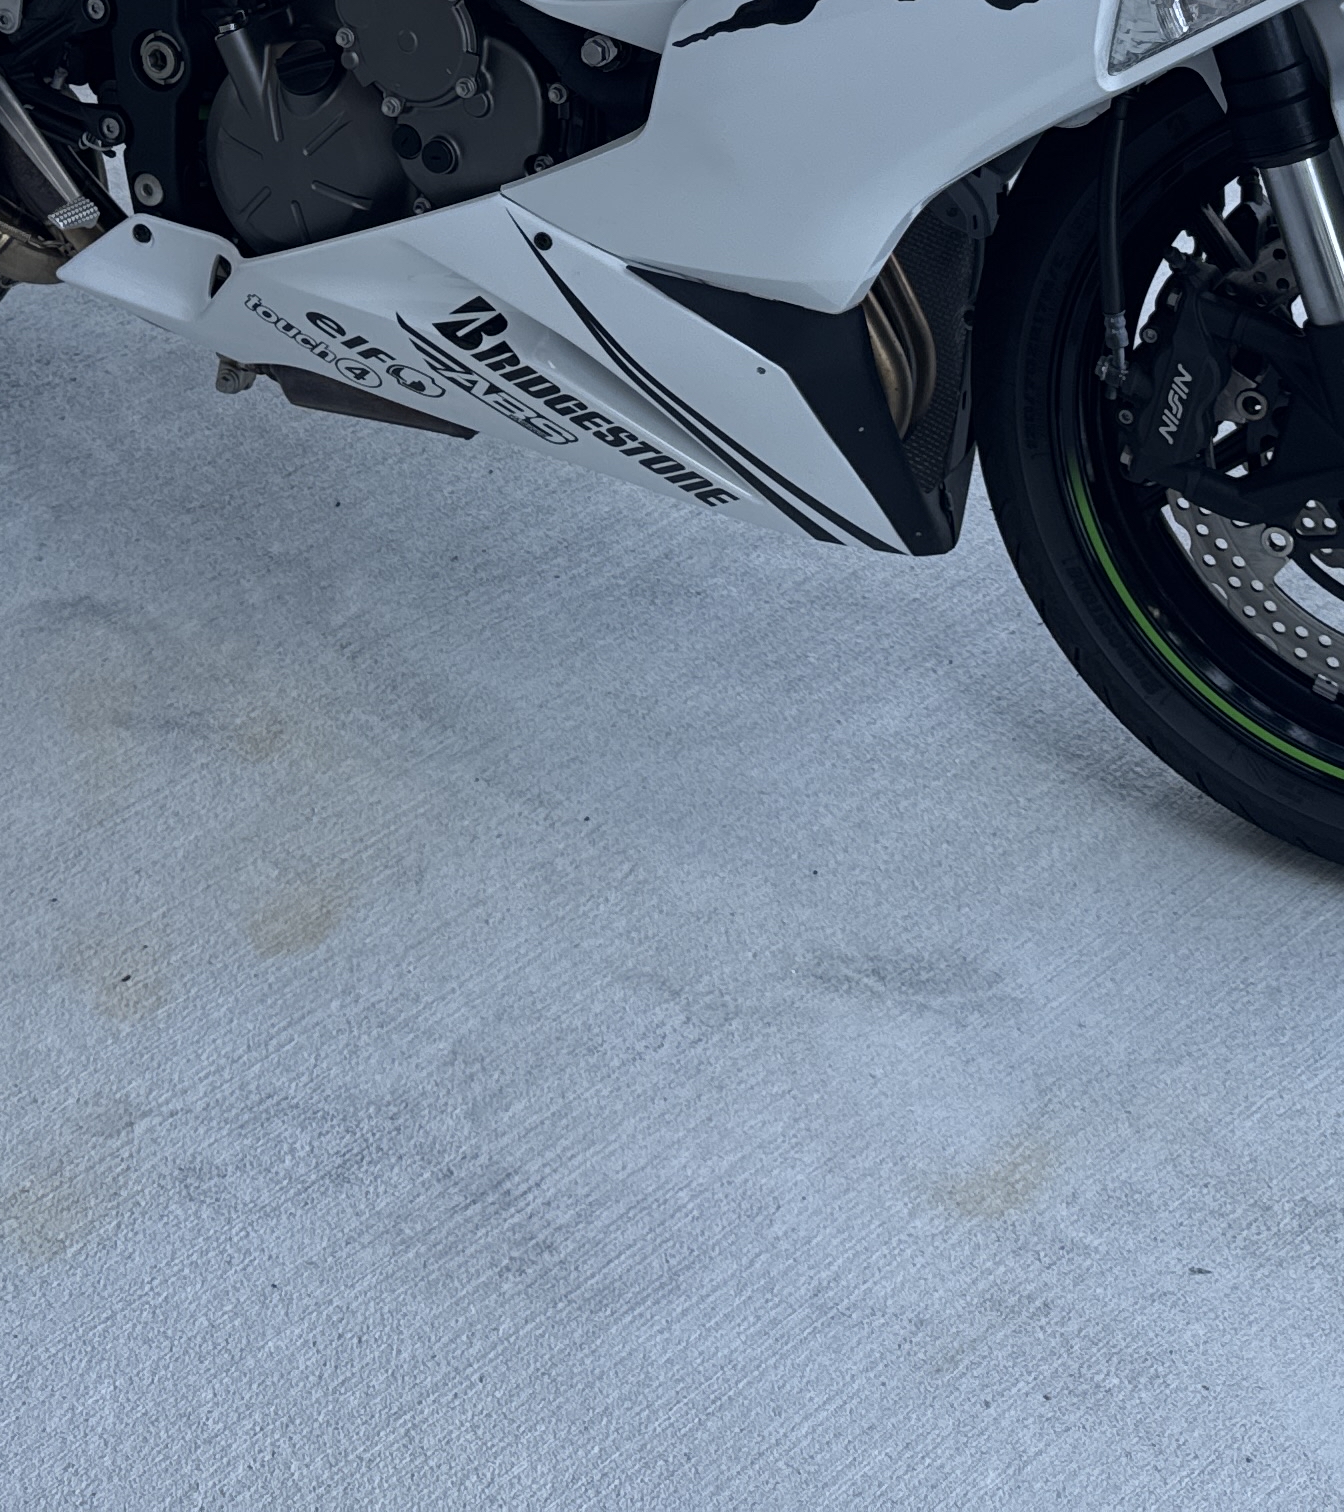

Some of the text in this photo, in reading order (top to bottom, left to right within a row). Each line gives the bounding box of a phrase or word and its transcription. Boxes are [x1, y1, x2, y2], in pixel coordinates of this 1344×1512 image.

[244, 293, 338, 364] touch
[432, 295, 741, 508] BRIDGESTONE
[1158, 363, 1193, 445] NISSIN
